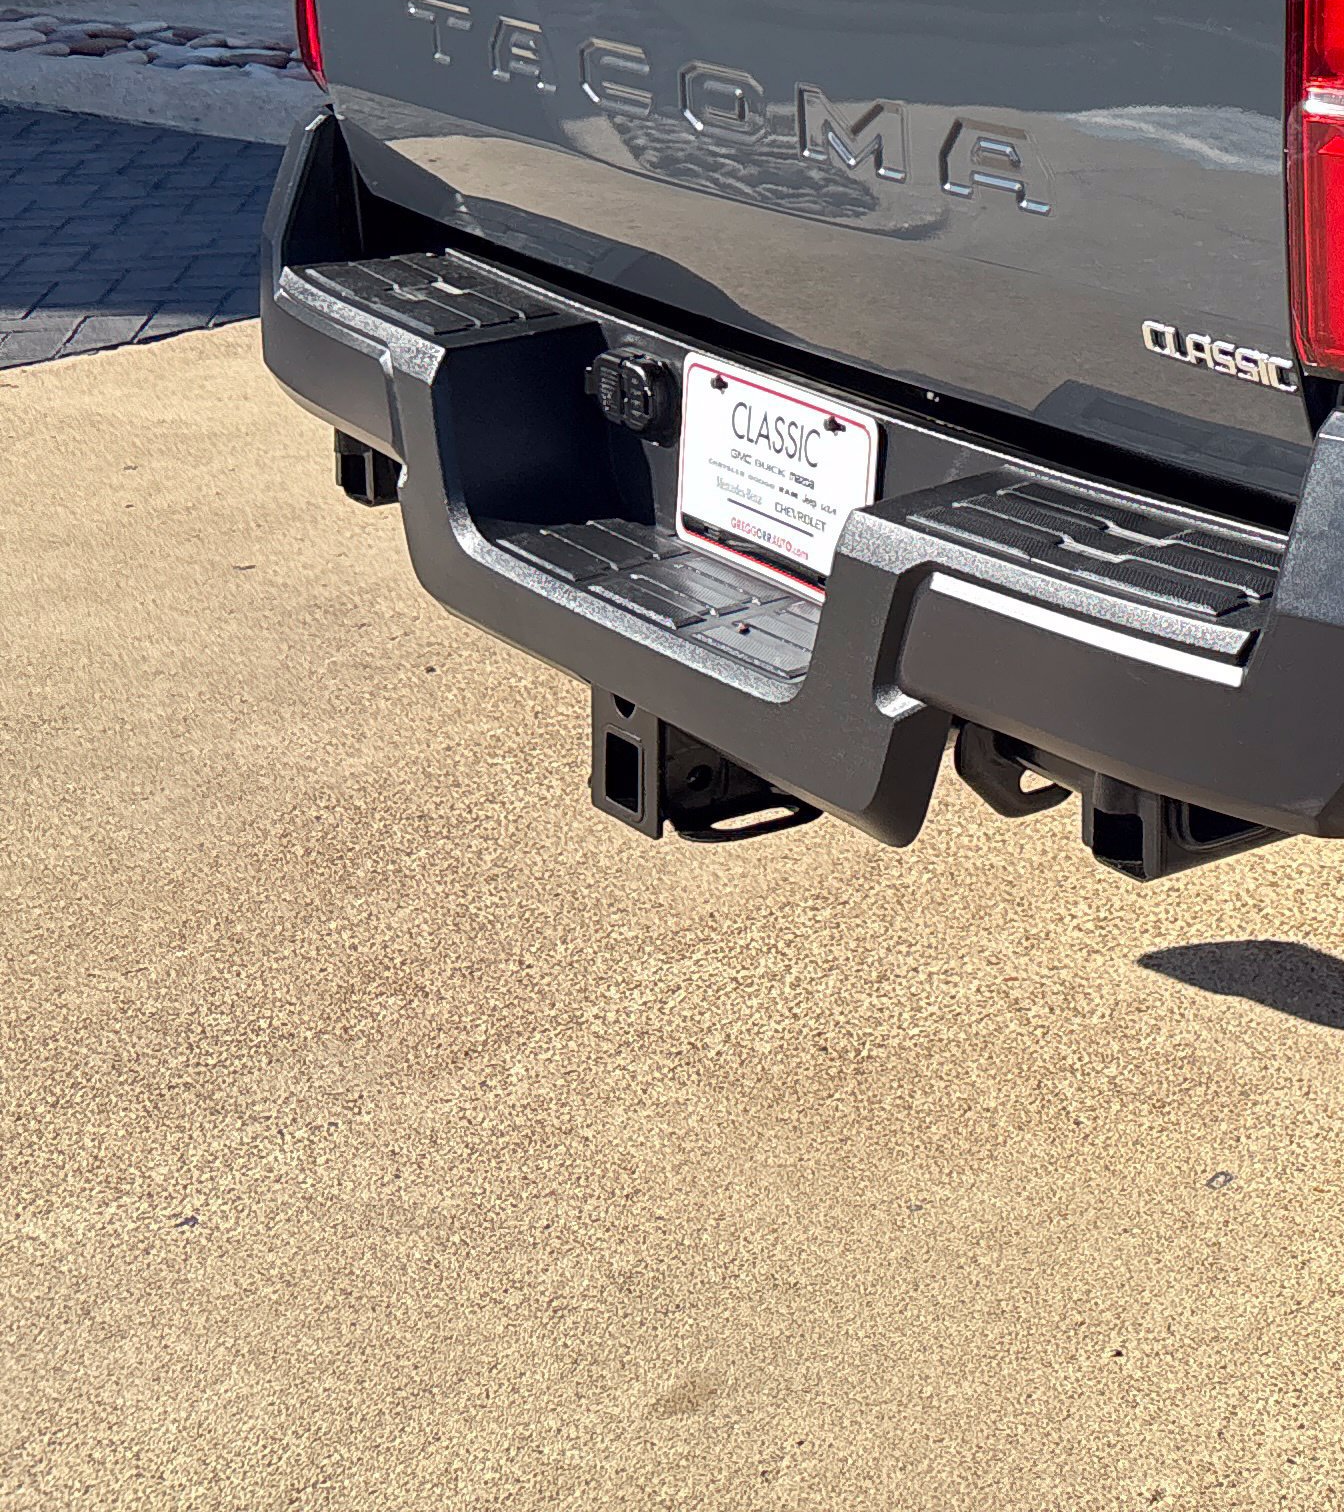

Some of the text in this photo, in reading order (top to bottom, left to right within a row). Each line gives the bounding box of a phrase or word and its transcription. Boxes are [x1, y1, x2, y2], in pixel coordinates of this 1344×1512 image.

[1141, 319, 1299, 393] CLASSIC
[731, 401, 821, 468] CLASSIC
[730, 448, 752, 465] GMC
[754, 458, 786, 478] BUICK
[774, 501, 828, 533] CHEVROLET
